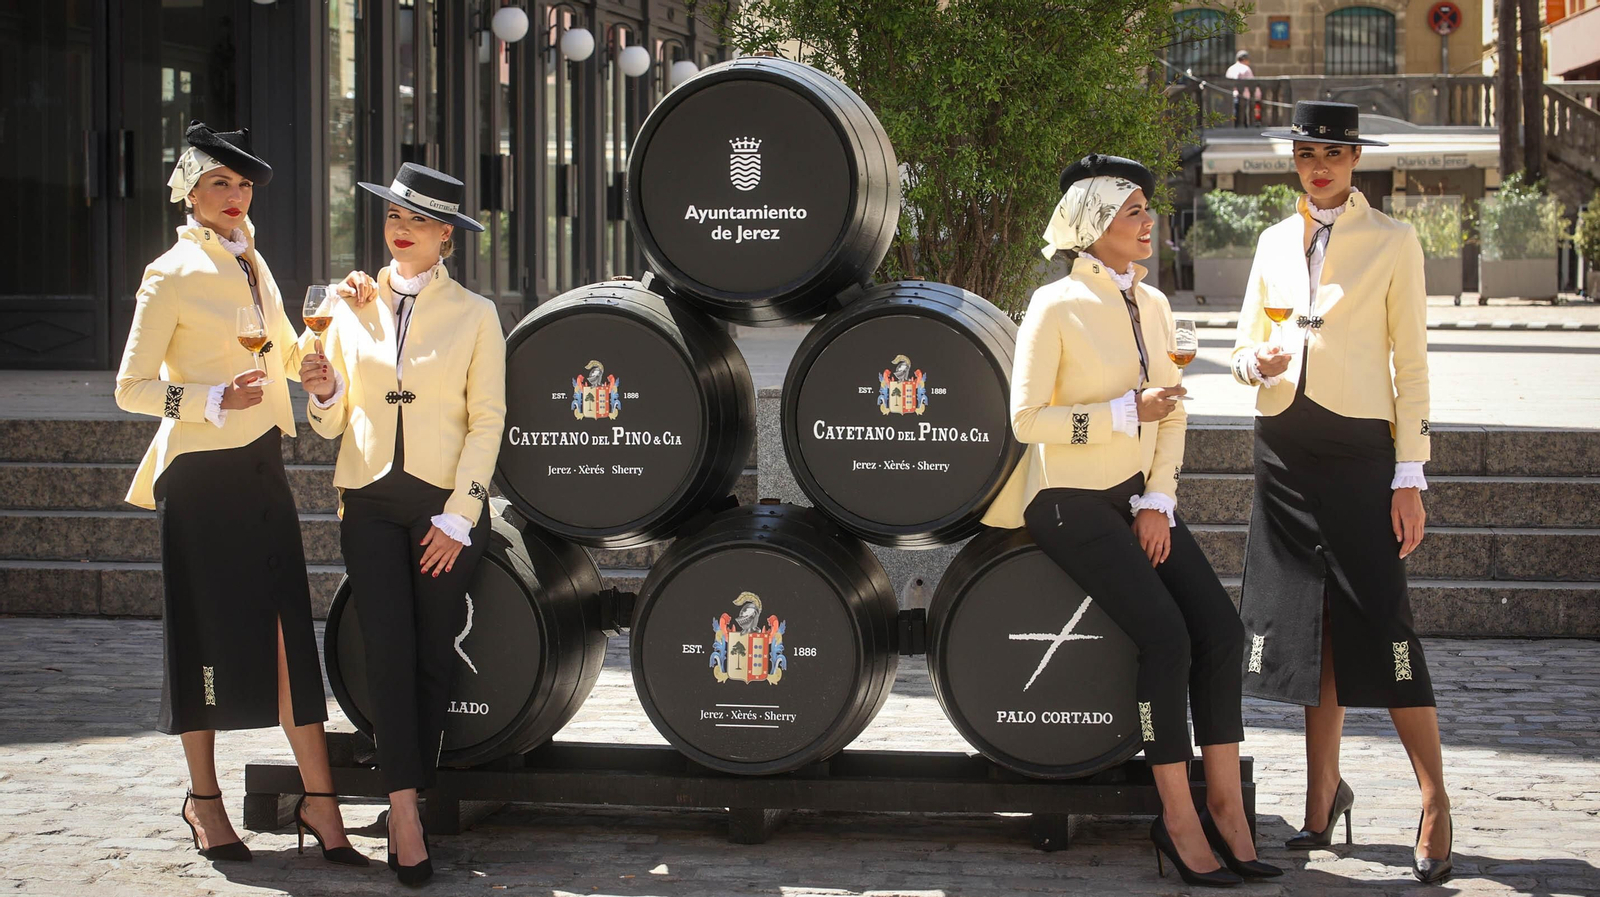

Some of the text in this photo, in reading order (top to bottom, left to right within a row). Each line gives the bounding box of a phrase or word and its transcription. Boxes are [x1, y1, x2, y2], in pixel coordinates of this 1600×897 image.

[684, 204, 808, 224] Ayuntamiento
[711, 225, 780, 244] de Jerez
[551, 392, 568, 400] EST.
[857, 386, 947, 395] EST. 1886
[653, 436, 662, 445] &
[959, 432, 968, 442] &
[547, 464, 643, 477] Jerez Xèrés Sherry
[852, 459, 950, 473] Jerez Xèrés Sherry
[681, 644, 817, 657] EST. 1886
[699, 709, 797, 723] Jerez Xèrés Sherry
[996, 711, 1113, 724] PALO CORTADO
